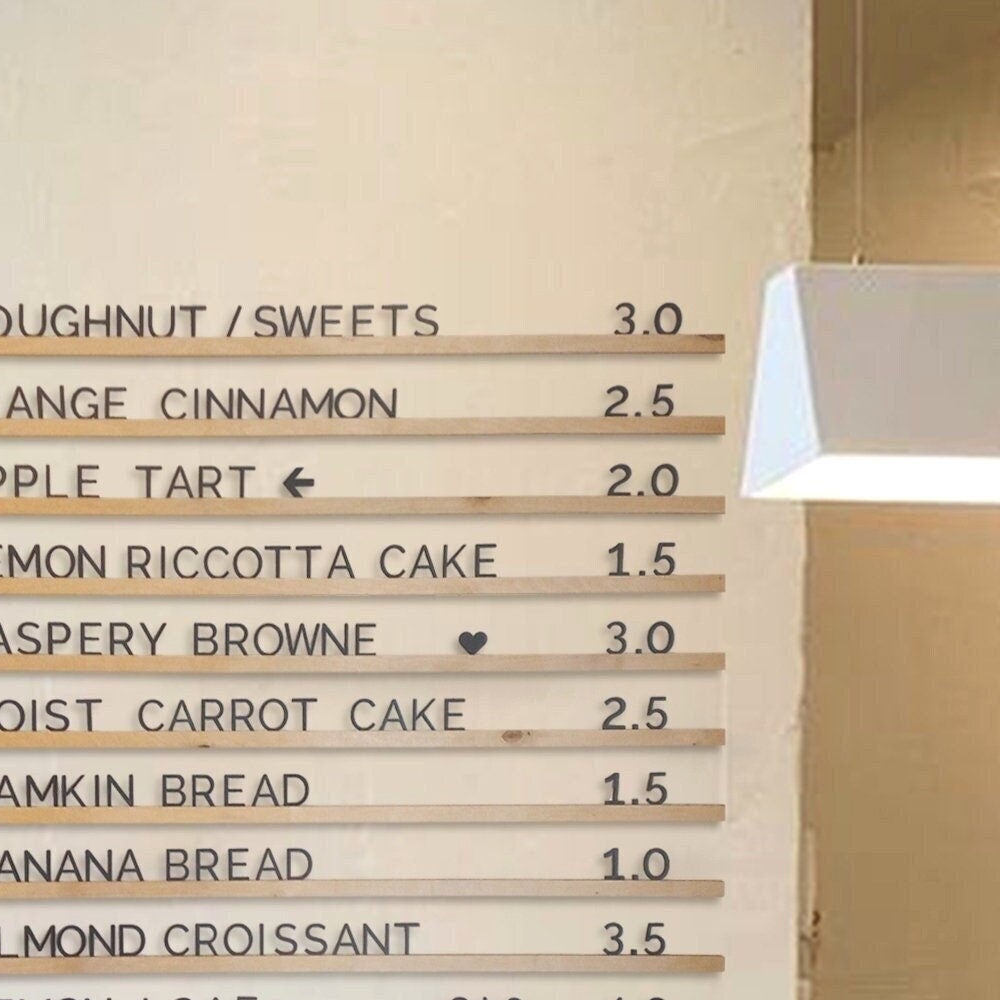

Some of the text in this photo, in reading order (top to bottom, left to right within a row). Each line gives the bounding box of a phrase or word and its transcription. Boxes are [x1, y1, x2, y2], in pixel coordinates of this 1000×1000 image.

[613, 302, 683, 336] 3.0
[160, 387, 398, 420] CINNAMON
[603, 383, 675, 417] 2.5
[134, 465, 256, 499] TART
[606, 463, 680, 497] 2.0
[126, 544, 356, 579] RICCOTTA
[379, 543, 498, 579] CAKE
[608, 541, 676, 576] 1.5
[192, 622, 377, 656] BROWNE
[606, 620, 675, 655] 3.0
[137, 697, 318, 732] CARROT
[349, 697, 466, 731] CAKE
[601, 696, 668, 730] 2.5
[161, 773, 310, 807] BREAD
[603, 771, 670, 806] 1.5
[165, 847, 313, 882] BREAD
[603, 847, 671, 881] 1.0
[161, 922, 421, 957] CROISSANT
[603, 921, 669, 957] 3.5
